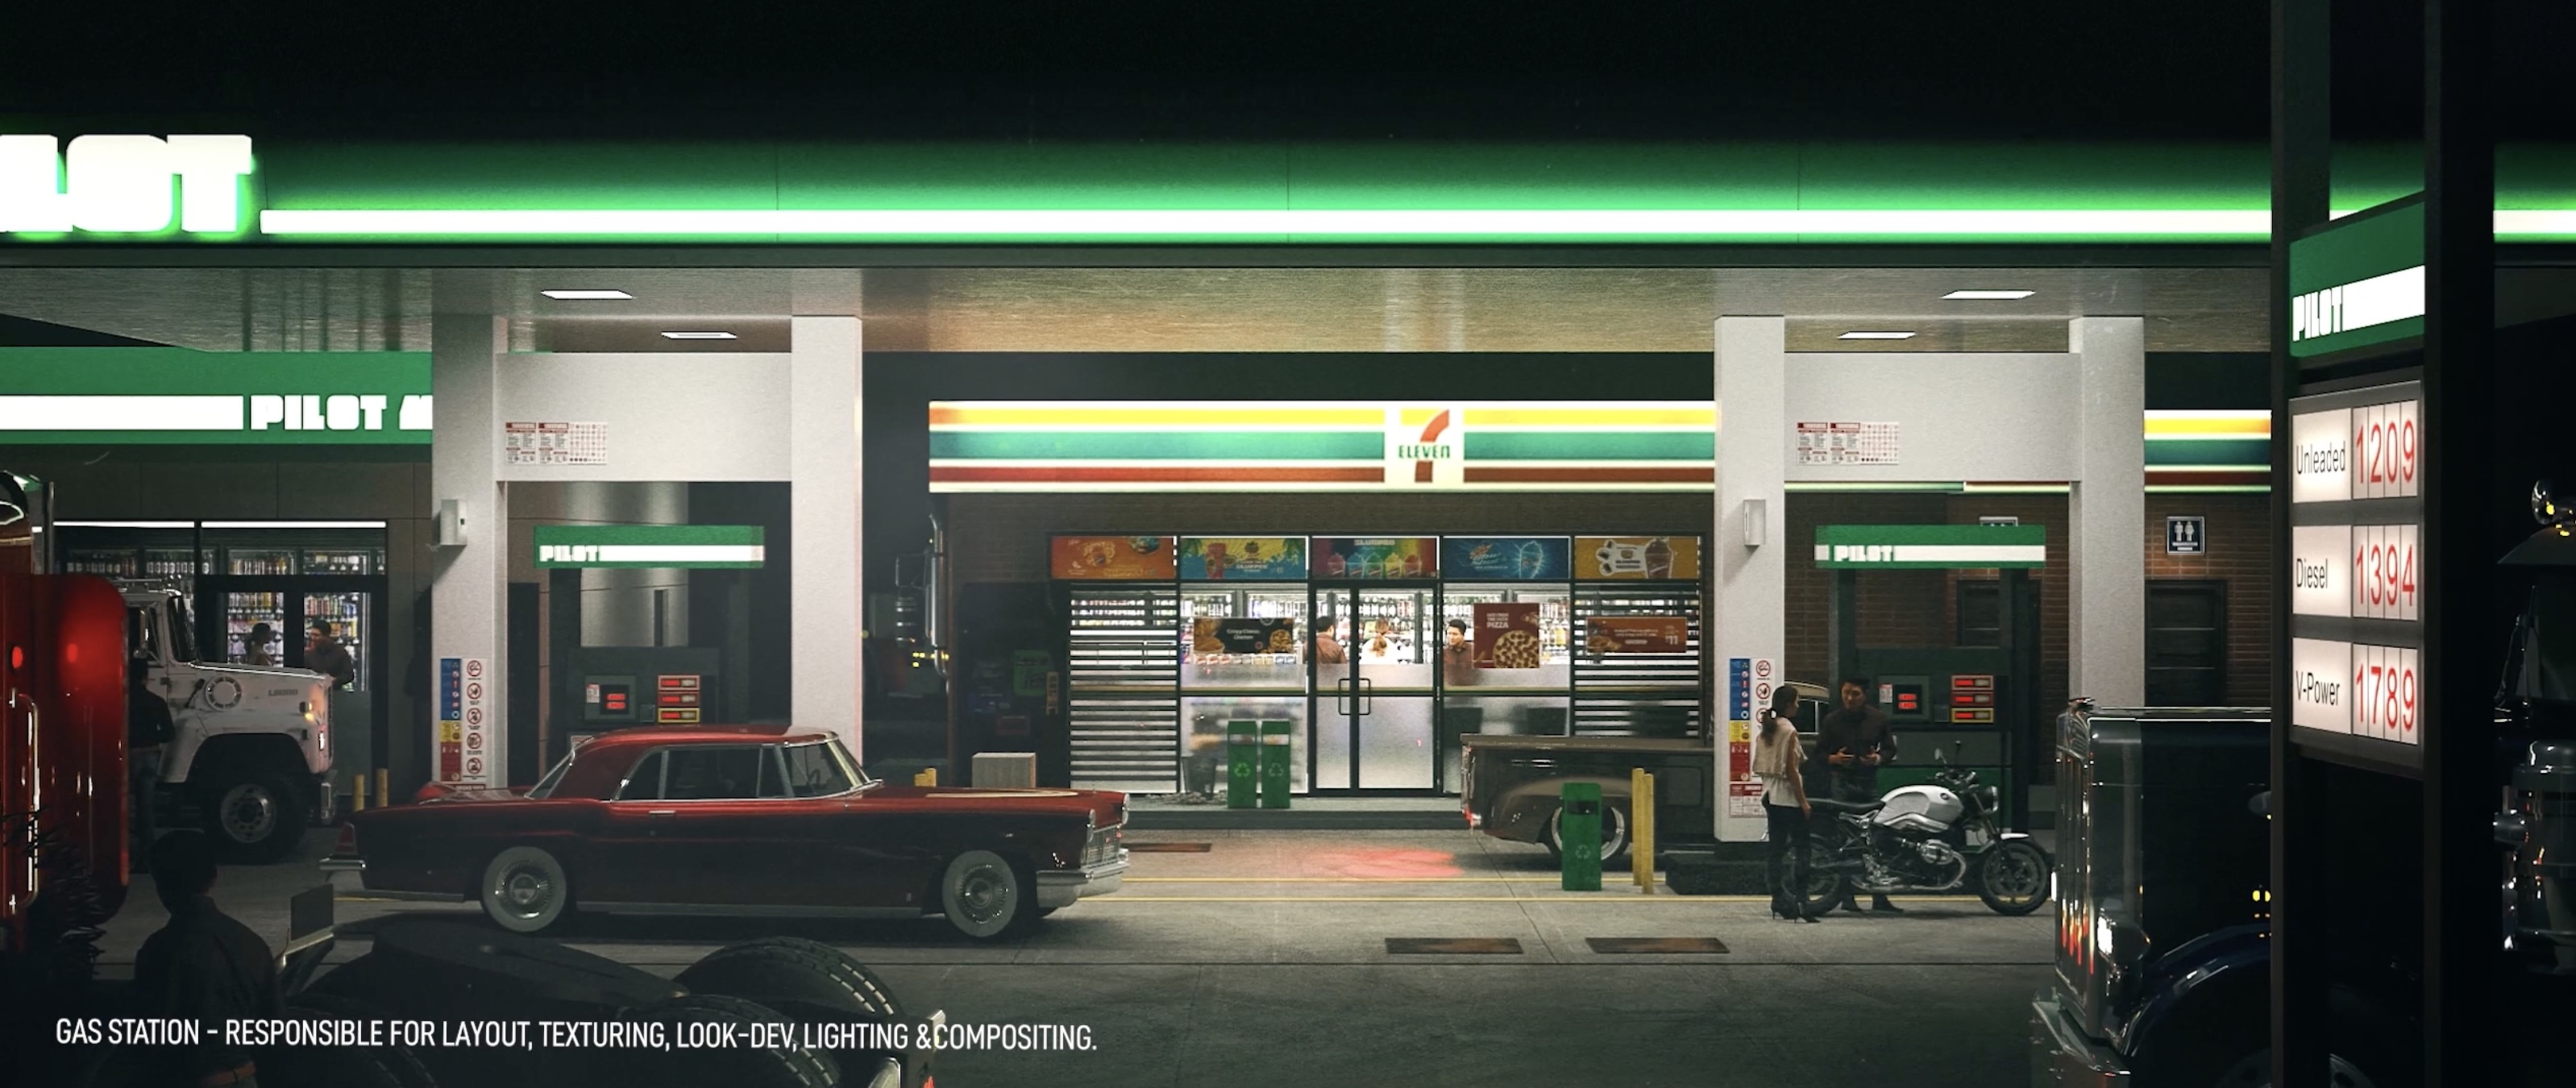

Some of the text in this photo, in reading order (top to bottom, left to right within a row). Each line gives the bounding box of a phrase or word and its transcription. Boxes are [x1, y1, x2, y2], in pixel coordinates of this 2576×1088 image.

[2292, 285, 2342, 342] PILOT
[251, 395, 387, 430] PILOT
[2296, 418, 2415, 484] Unleaded 1209
[539, 545, 597, 562] PILOT
[1834, 545, 1893, 562] PILOT
[2296, 543, 2415, 606] Diesel 1394
[2296, 663, 2415, 732] V-Power 1789
